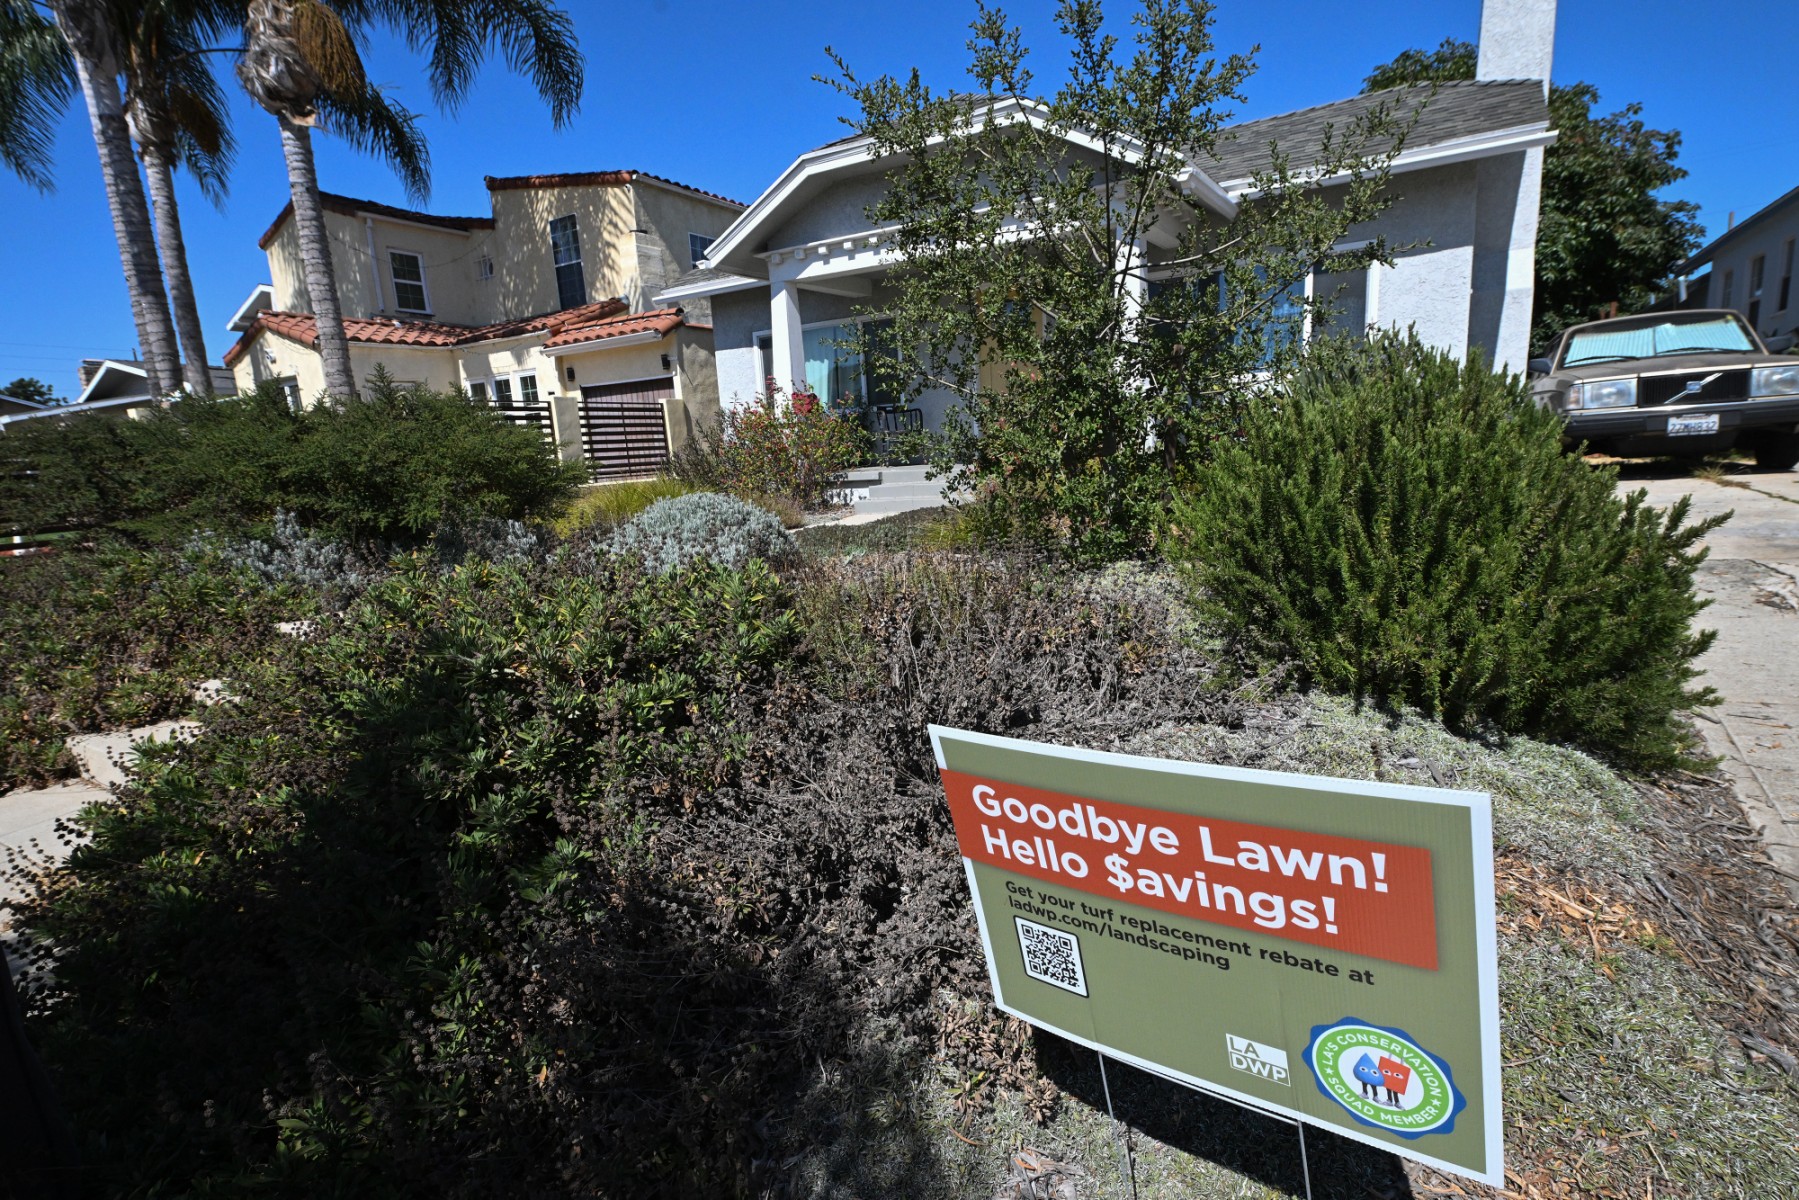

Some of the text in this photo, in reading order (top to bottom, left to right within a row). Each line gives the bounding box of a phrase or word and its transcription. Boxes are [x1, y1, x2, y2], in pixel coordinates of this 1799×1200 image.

[972, 784, 1388, 893] Goodbye Lawn!
[981, 824, 1338, 934] Hello $avings!
[1005, 880, 1375, 985] Get your turf replacement rebate at
[1008, 896, 1230, 970] ladwp.com/landscaping
[1229, 1036, 1260, 1058] LA
[1231, 1053, 1287, 1082] DWP
[1324, 1033, 1442, 1097] LA'S CONSERVATION
[1328, 1076, 1440, 1126] SQUAD MEMBER
